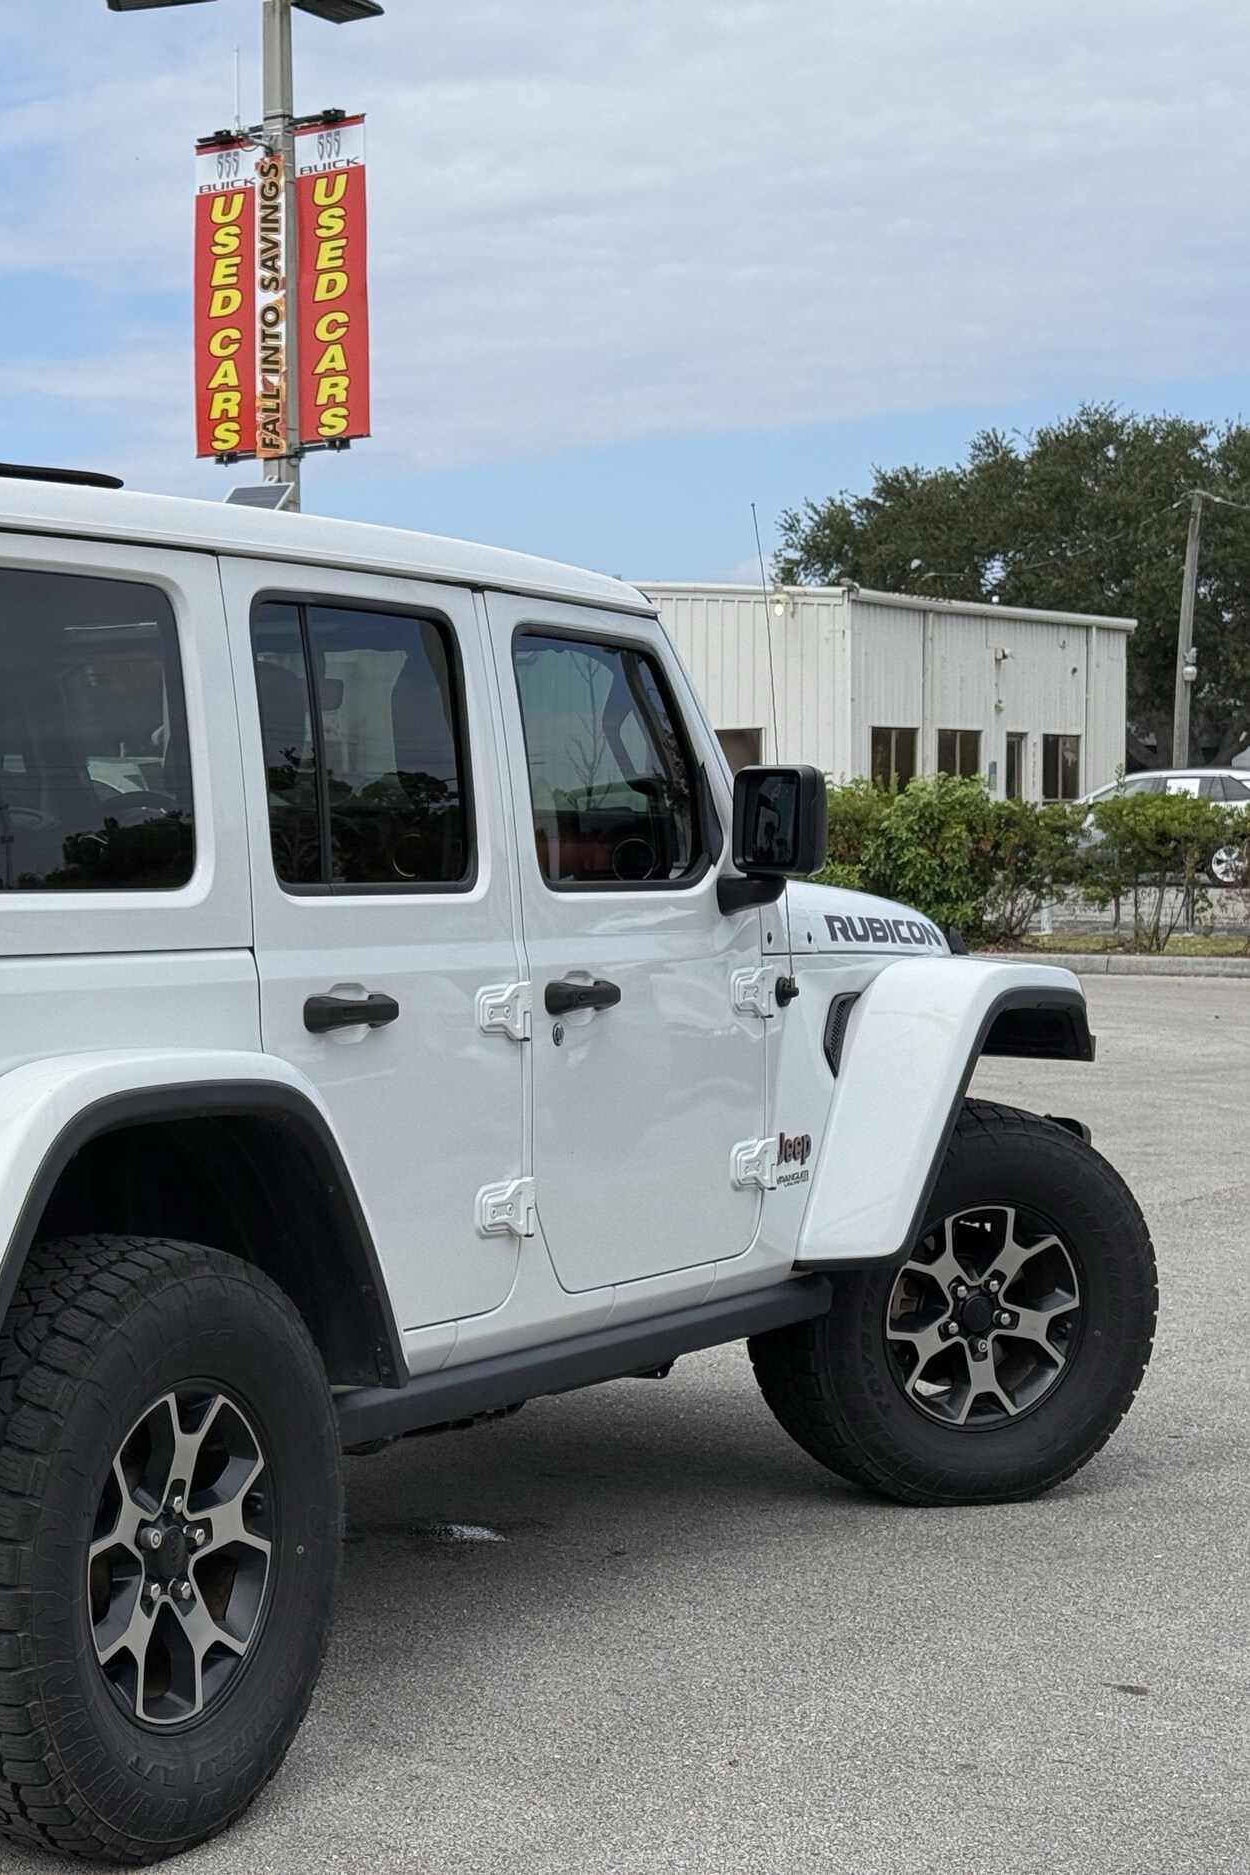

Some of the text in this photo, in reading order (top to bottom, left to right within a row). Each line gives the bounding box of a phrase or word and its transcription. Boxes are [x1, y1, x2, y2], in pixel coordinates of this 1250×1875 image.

[300, 156, 360, 176] BUICK
[199, 177, 256, 194] BUICK
[206, 192, 246, 451] USED CARS
[258, 161, 283, 452] FALL INTO SAVINGS
[312, 173, 350, 438] USED CARS
[824, 915, 943, 947] RUBICON
[776, 1132, 812, 1166] Jeep
[776, 1170, 810, 1185] WRANGLER
